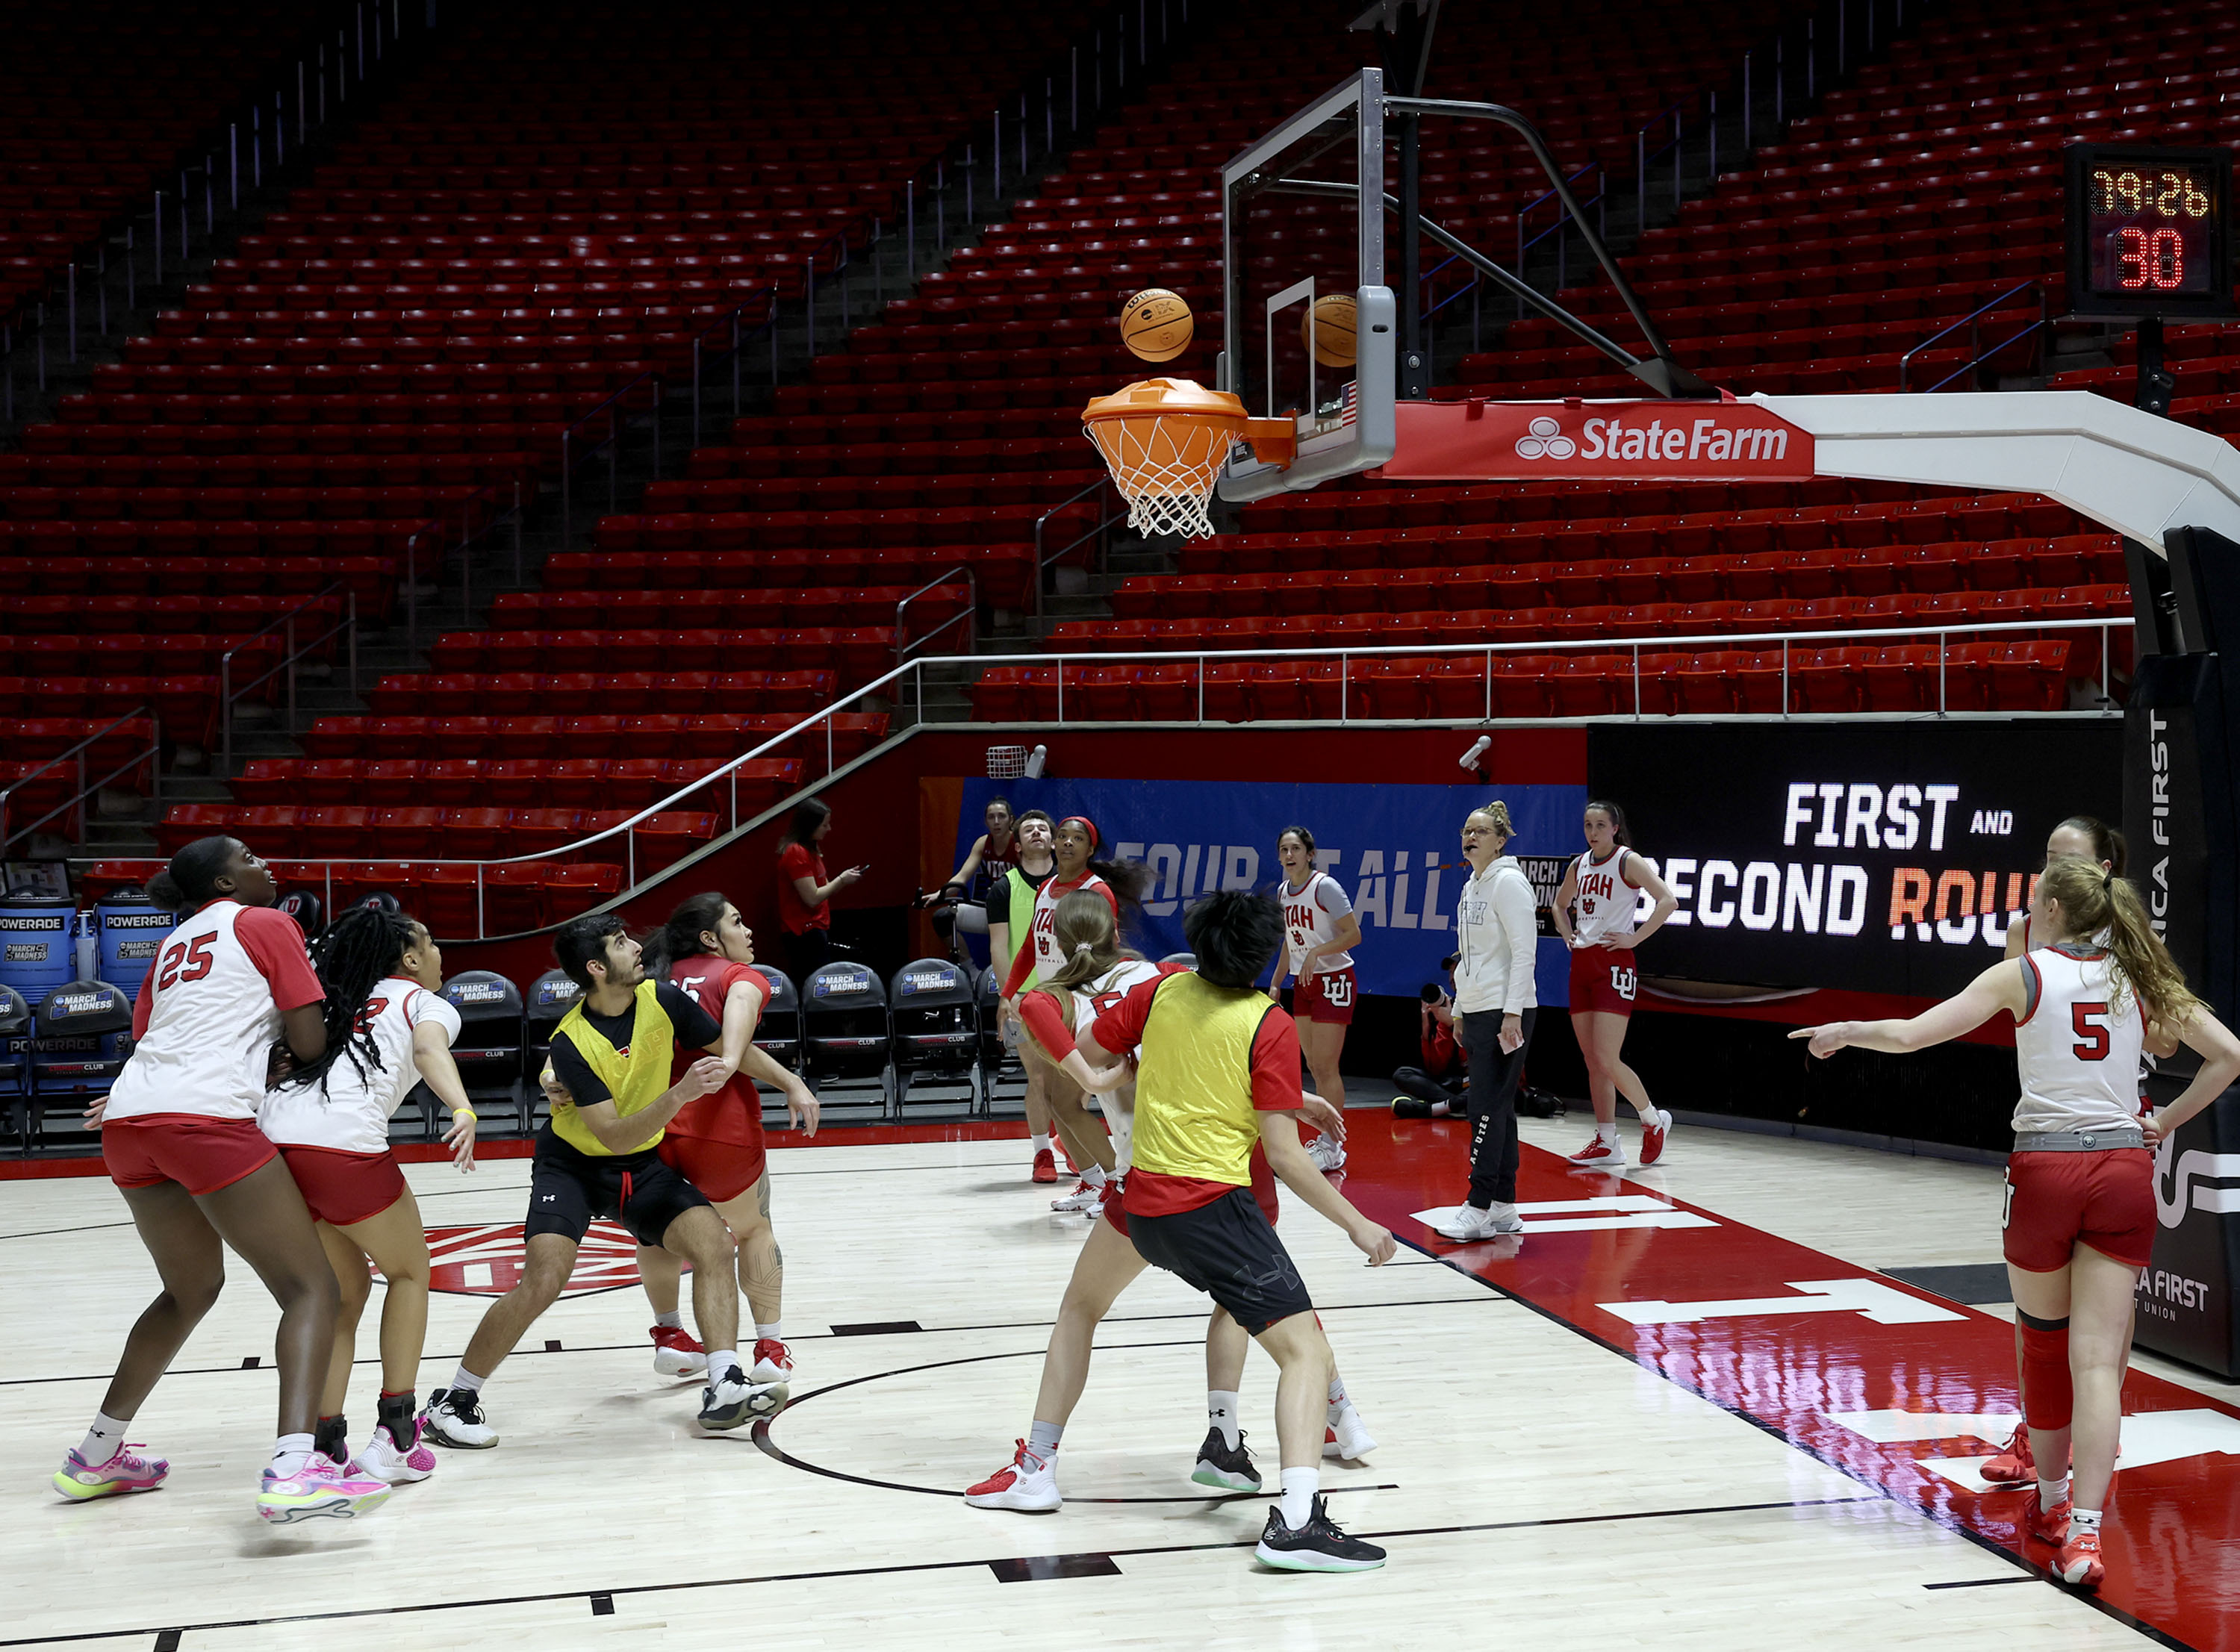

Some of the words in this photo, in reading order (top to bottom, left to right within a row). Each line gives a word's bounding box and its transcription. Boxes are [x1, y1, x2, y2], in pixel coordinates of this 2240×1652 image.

[2121, 228, 2183, 288] 30
[2150, 708, 2170, 847] FIRST
[1783, 782, 1960, 852] FIRST
[1969, 808, 2015, 835] AND
[1519, 860, 1559, 883] ARCH
[1354, 850, 1450, 931] ALL
[107, 915, 171, 927] POWERADE
[1284, 904, 1315, 932] TAH
[12, 944, 36, 953] MARCH
[14, 950, 48, 959] MADNESS
[128, 948, 157, 957] MADNES
[157, 930, 220, 993] 25
[826, 975, 854, 985] MARCH
[912, 973, 941, 982] MARCH
[459, 984, 490, 994] MARCH
[551, 982, 580, 991] MARC
[830, 981, 868, 991] MADNESS
[917, 979, 954, 989] MADNESS
[64, 994, 96, 1005] MARCH
[463, 990, 504, 1001] MADNESS
[69, 1000, 113, 1012] MADNESS
[2071, 1001, 2111, 1062] 5
[1475, 1115, 1490, 1144] UTES
[2154, 1270, 2209, 1312] FIRST
[2144, 1300, 2177, 1322] UNION
